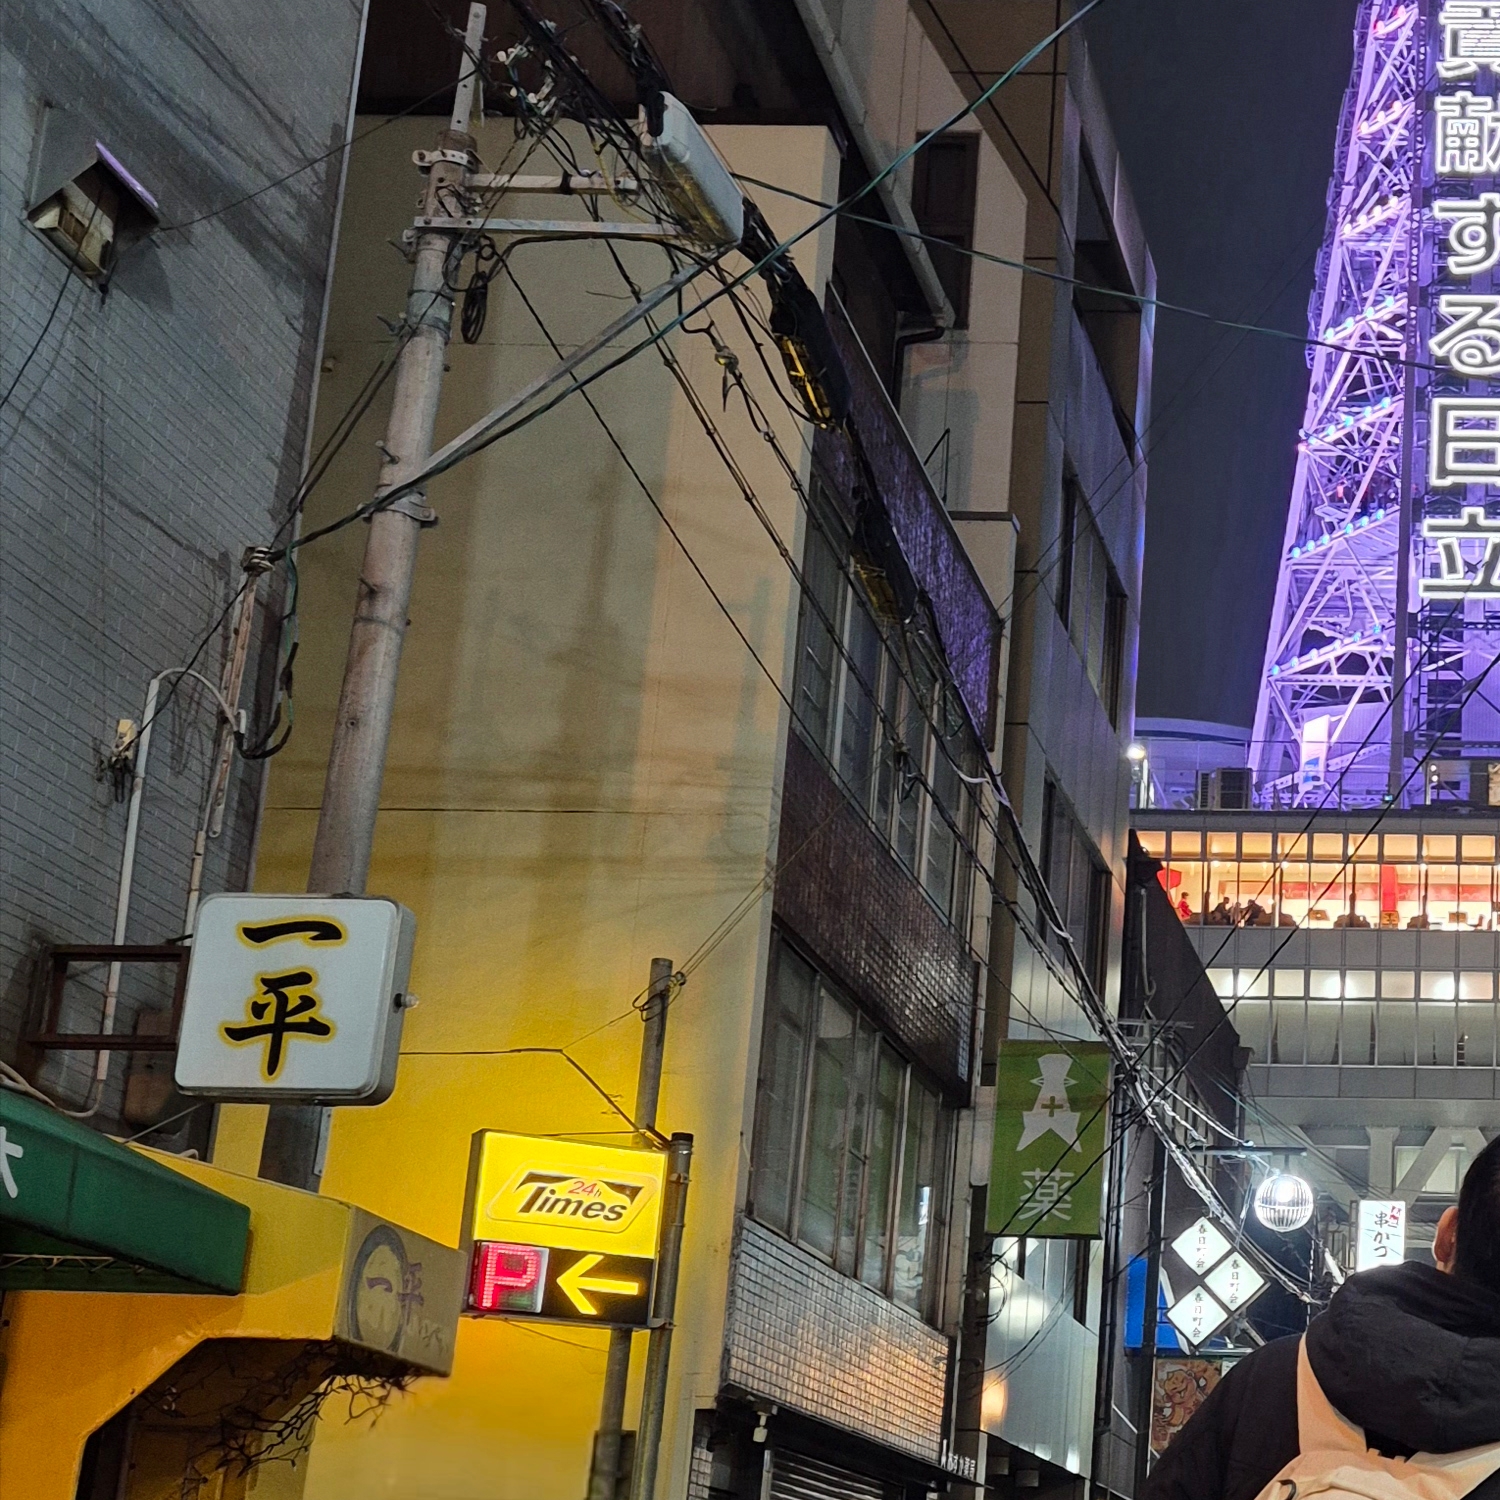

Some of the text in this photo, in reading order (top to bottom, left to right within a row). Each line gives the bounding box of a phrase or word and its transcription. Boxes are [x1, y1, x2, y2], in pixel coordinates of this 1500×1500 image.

[222, 919, 343, 1078] 一平
[516, 1180, 629, 1222] Times
[1018, 1167, 1075, 1222] 薬
[1373, 1210, 1390, 1258] 串かつ
[479, 1243, 541, 1310] P
